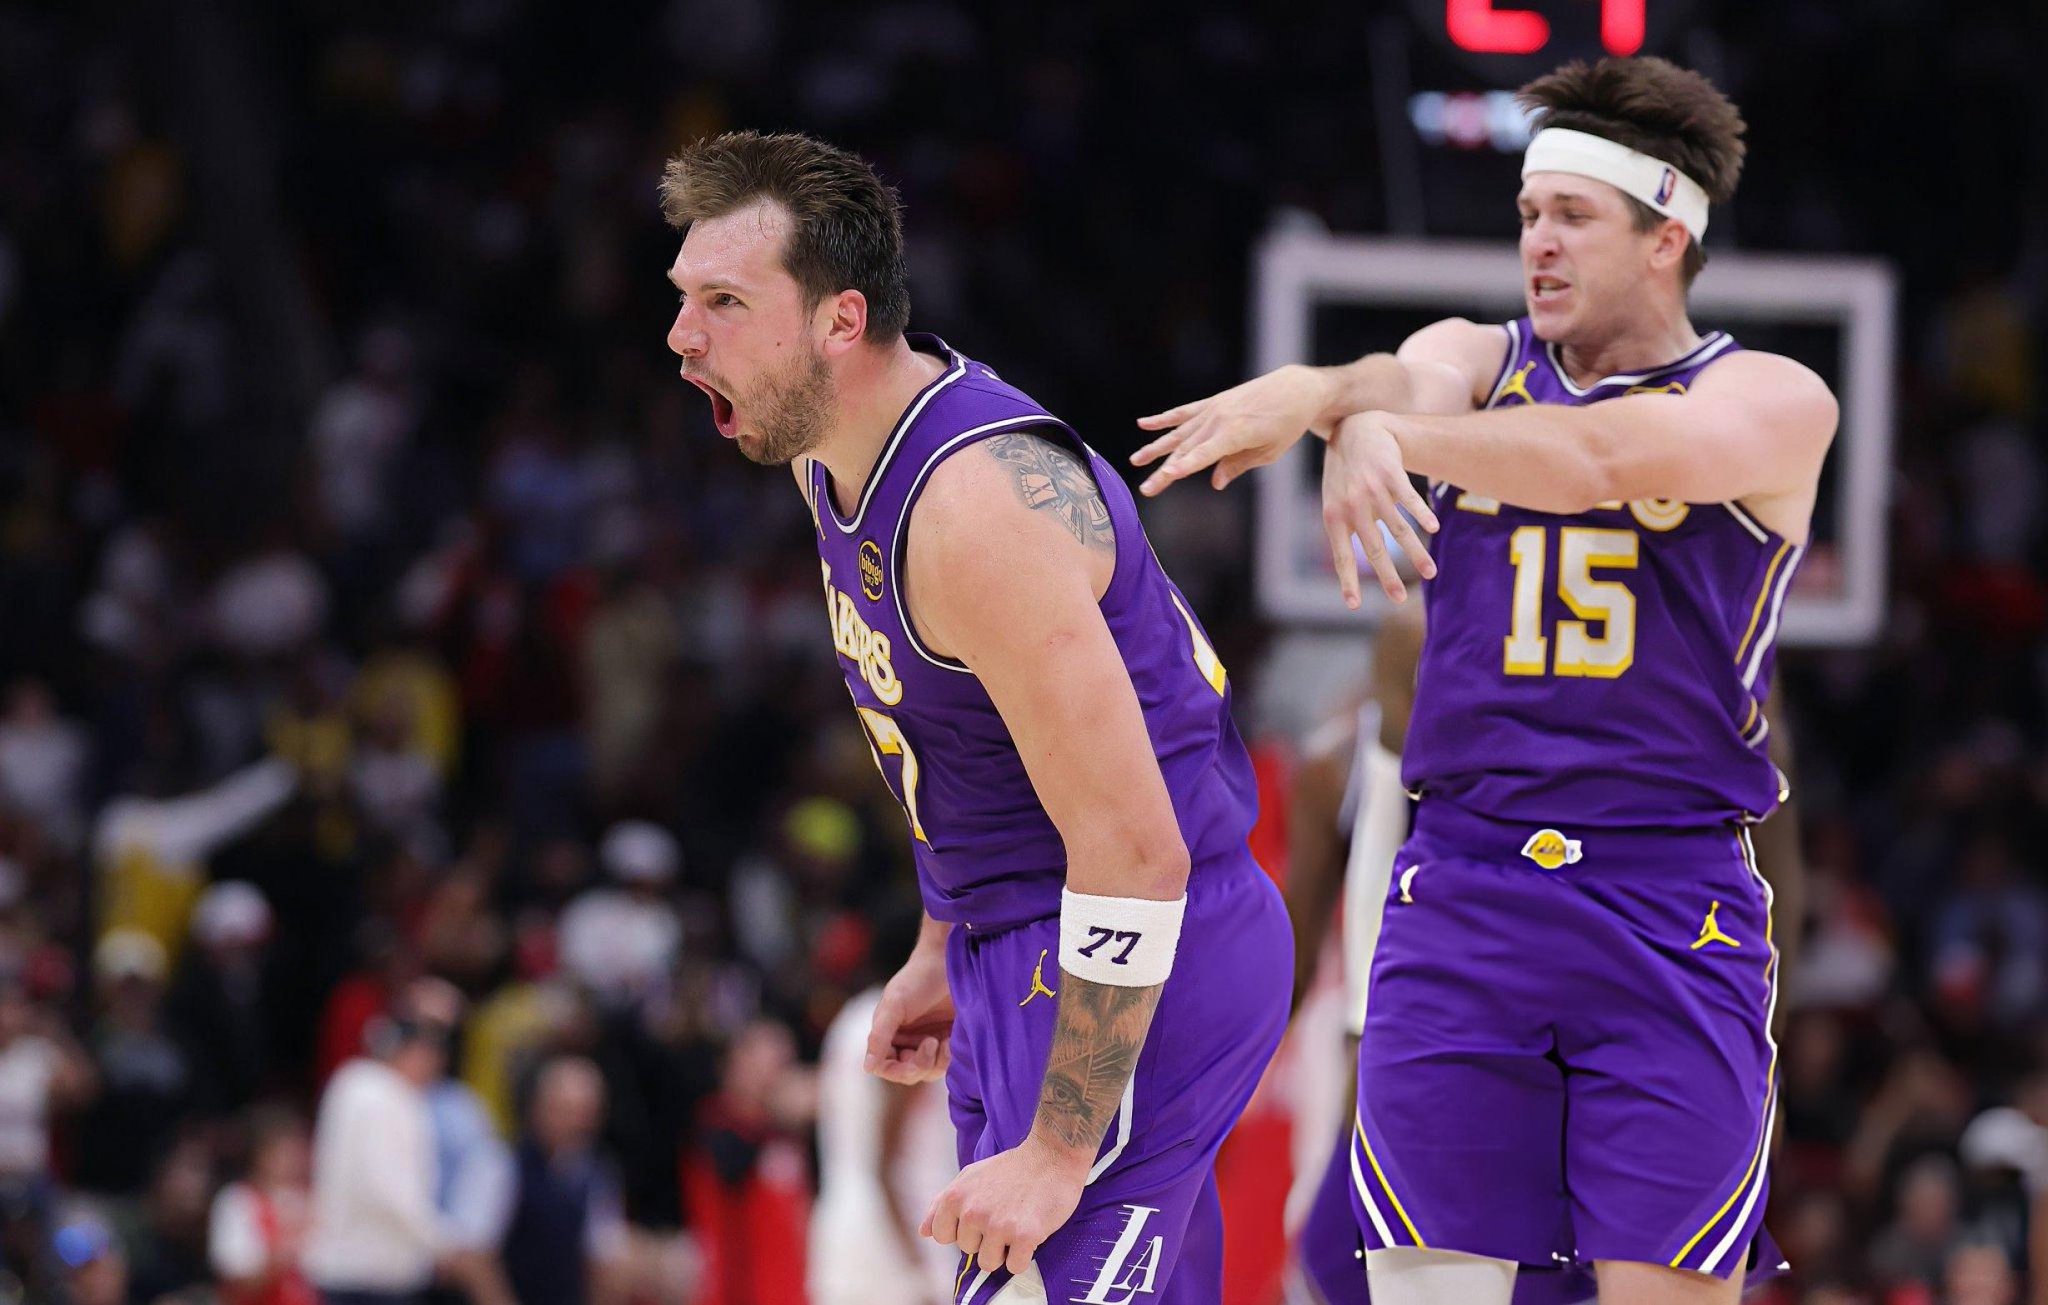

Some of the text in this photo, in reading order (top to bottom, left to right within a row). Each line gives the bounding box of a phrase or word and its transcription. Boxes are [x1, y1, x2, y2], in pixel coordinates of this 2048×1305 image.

[861, 552, 883, 586] bibigo
[1504, 525, 1640, 679] 15
[1078, 926, 1142, 965] 77
[1069, 1204, 1163, 1305] LA
